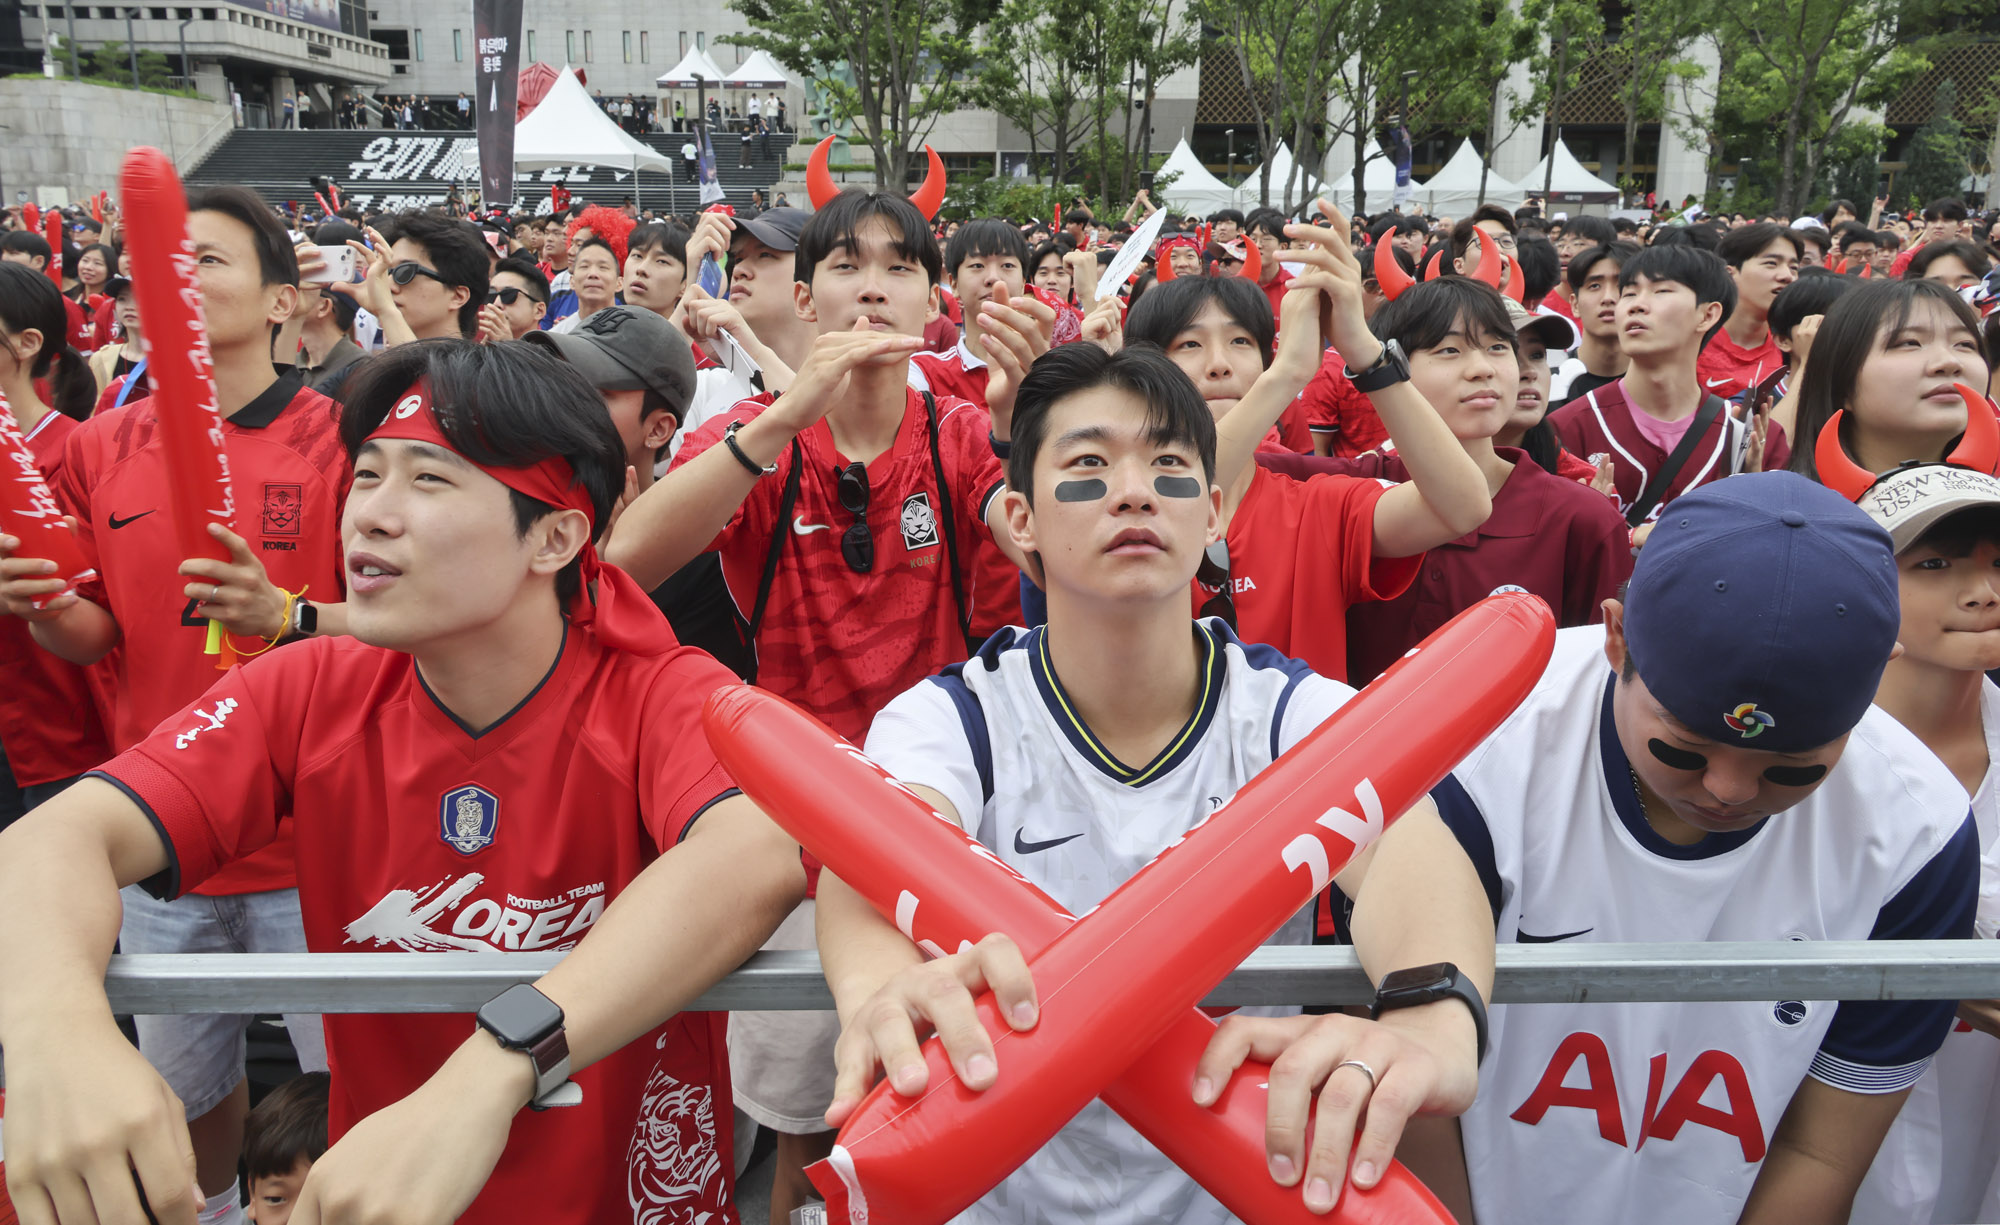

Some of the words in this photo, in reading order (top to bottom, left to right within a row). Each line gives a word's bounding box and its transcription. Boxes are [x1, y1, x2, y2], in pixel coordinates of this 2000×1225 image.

[1877, 474, 1932, 507] NEW
[1882, 490, 1932, 518] USA
[262, 541, 297, 551] KOREA
[506, 893, 567, 910] FOOTBALL
[566, 881, 605, 900] TEAM
[342, 872, 605, 953] KOREA
[1509, 1031, 1766, 1164] AIA
